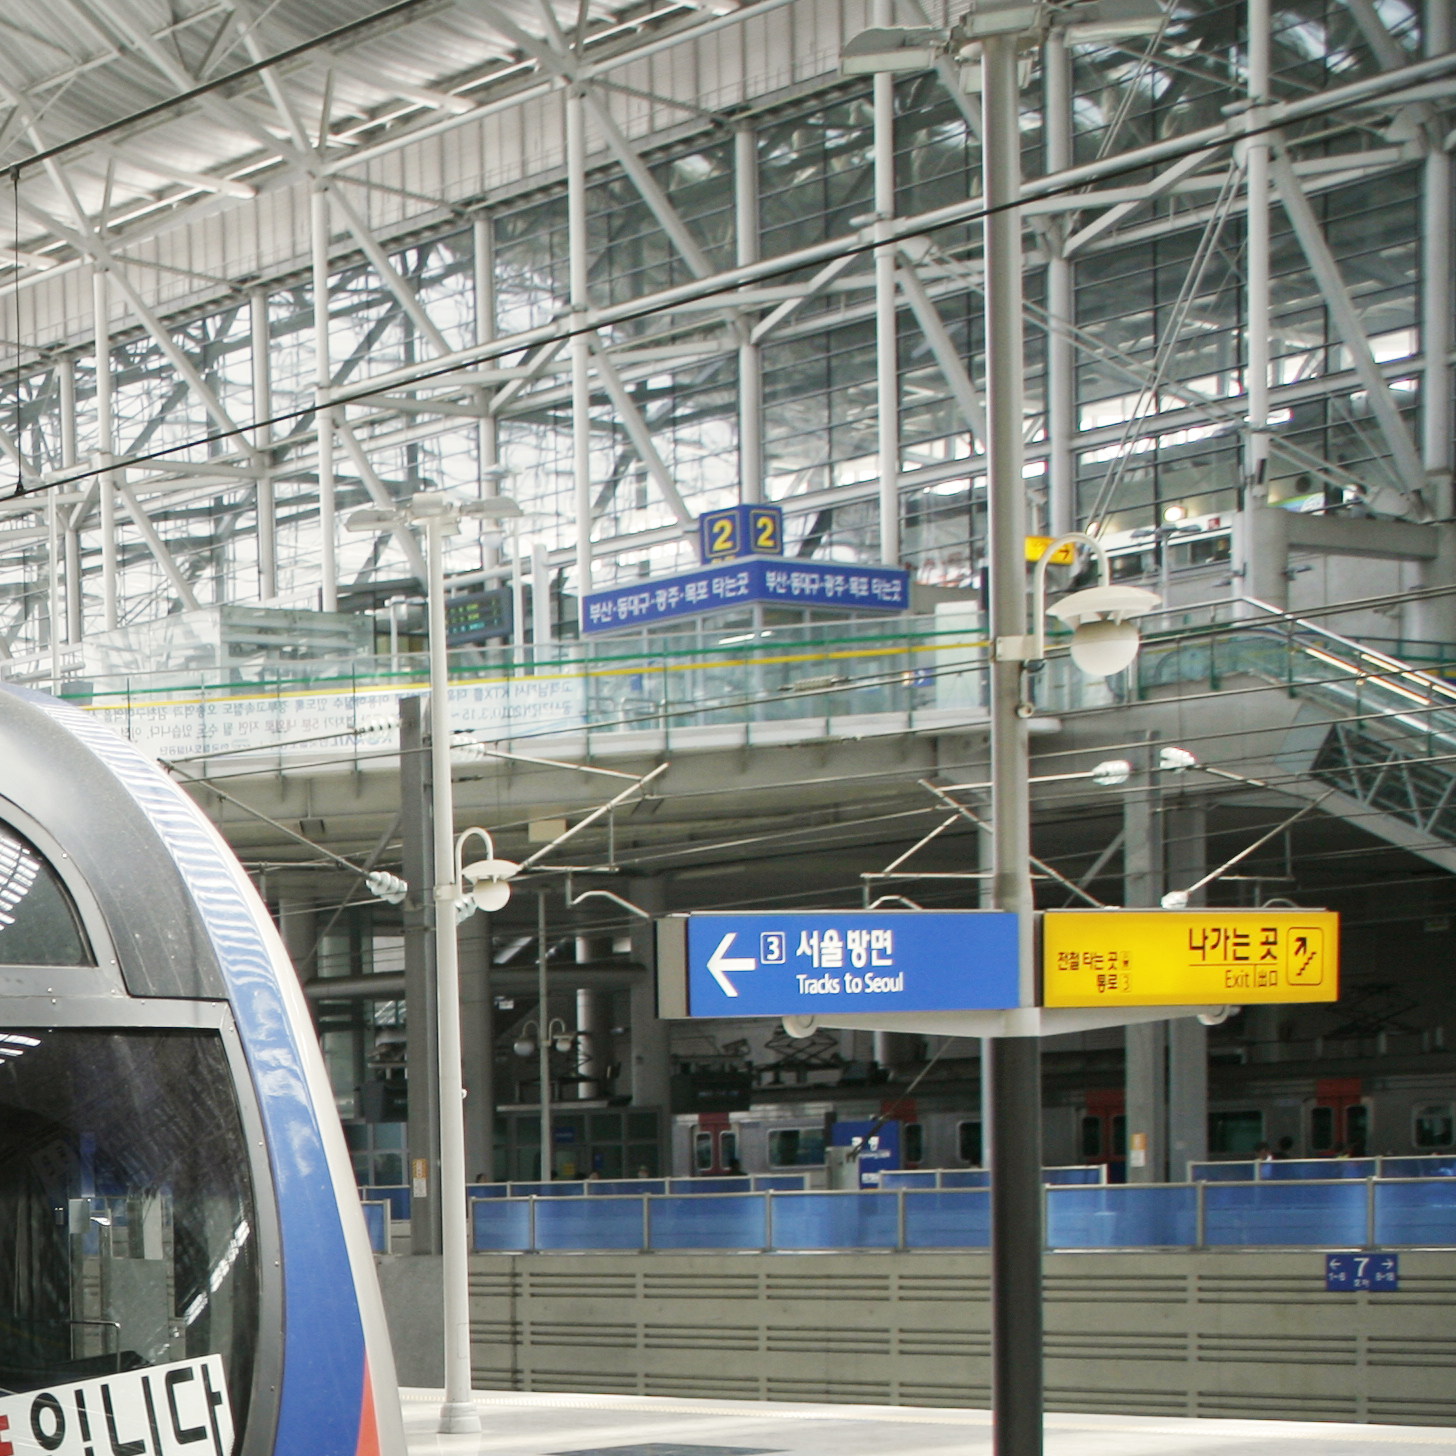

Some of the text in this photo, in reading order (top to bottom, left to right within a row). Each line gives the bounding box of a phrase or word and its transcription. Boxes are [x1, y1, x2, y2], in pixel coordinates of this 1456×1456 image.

[712, 519, 733, 551] 2
[756, 517, 776, 547] 2
[711, 570, 749, 598] 타는곳
[871, 578, 903, 602] 타는곳
[766, 936, 780, 960] 3
[796, 929, 893, 968] 서울 방면
[1189, 927, 1278, 962] 나가는 곳
[1057, 951, 1117, 971] 전철 타는 곳
[796, 971, 904, 994] Tracks to Seoul
[1097, 974, 1117, 993] 통로
[1225, 970, 1249, 989] Exit
[1257, 970, 1278, 988] 出口
[1353, 1257, 1370, 1277] 7
